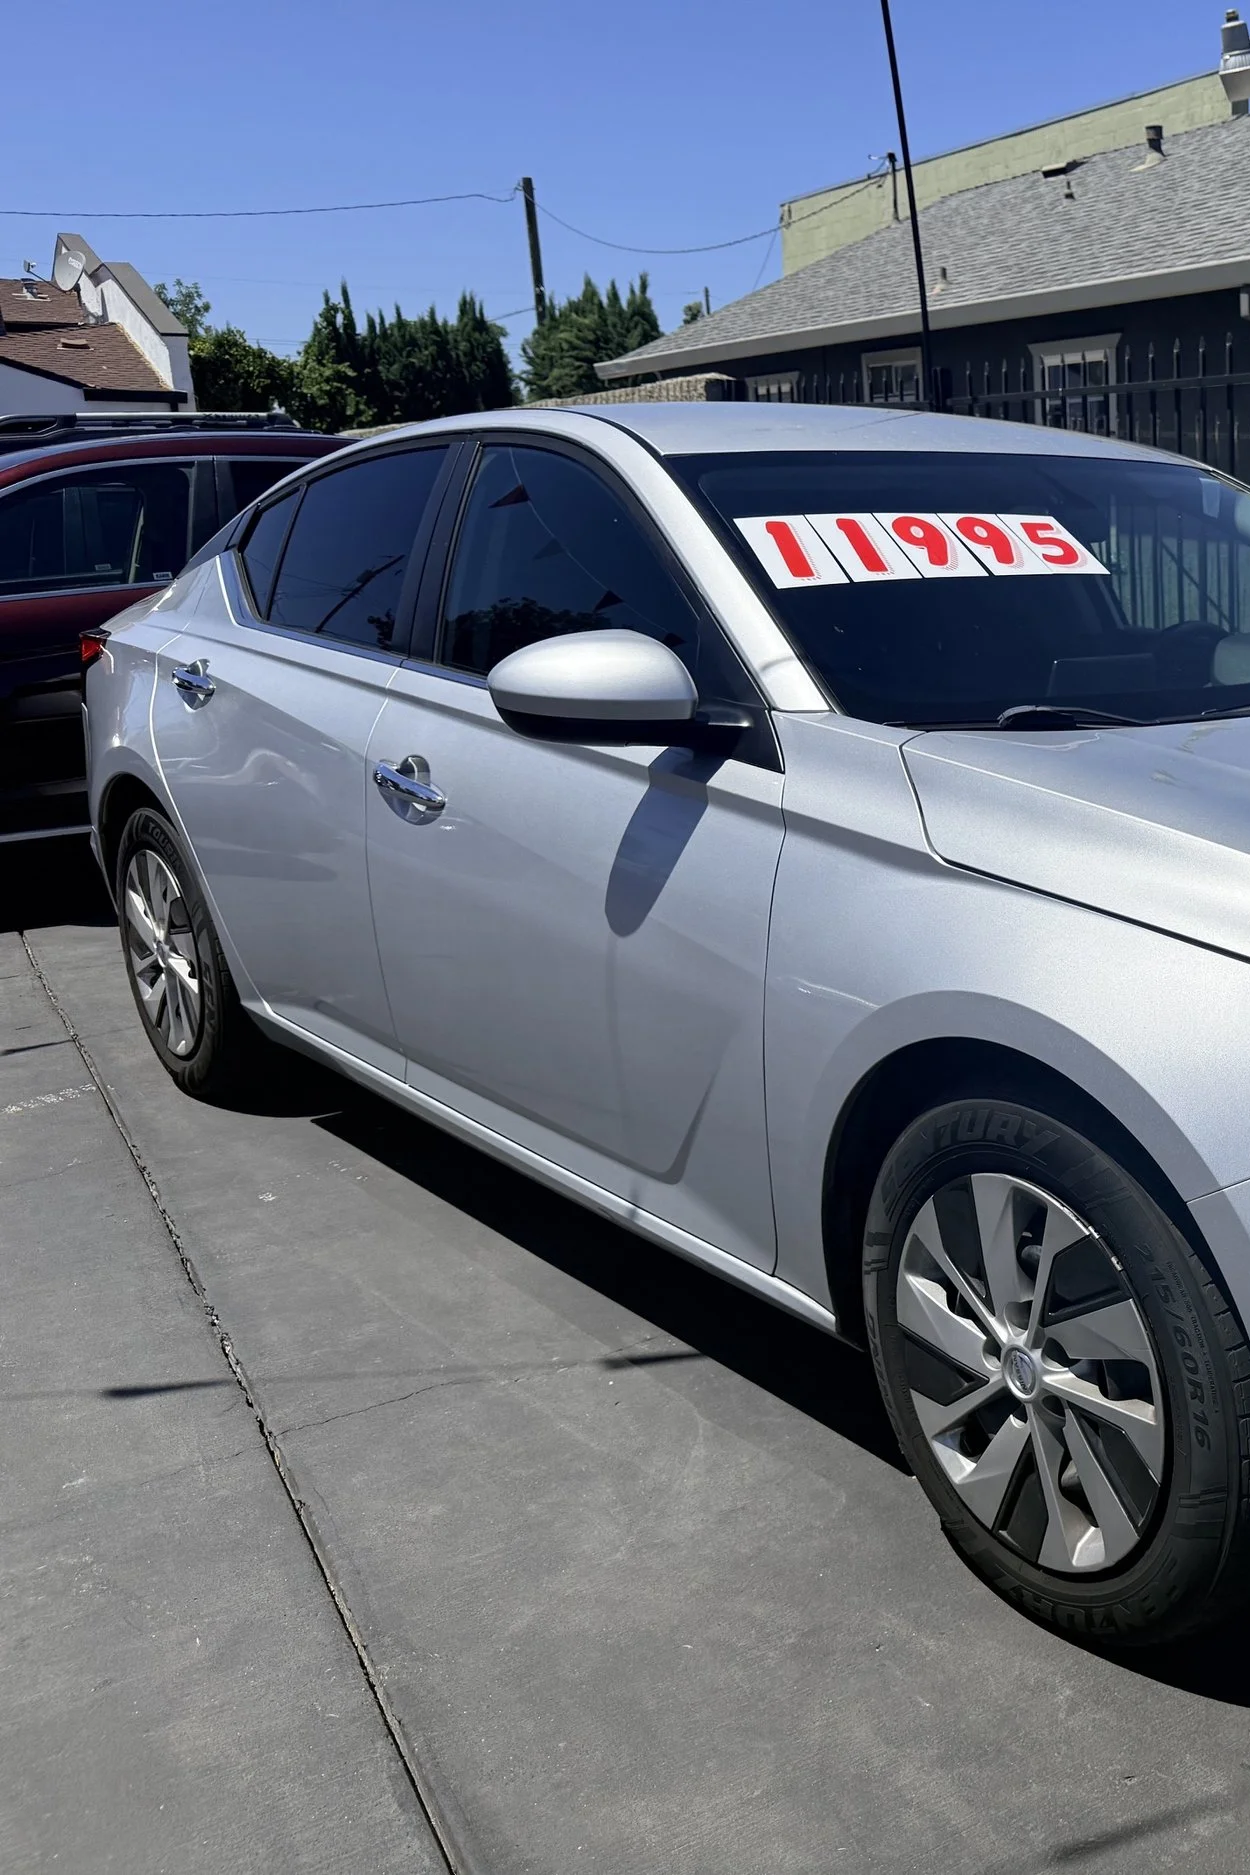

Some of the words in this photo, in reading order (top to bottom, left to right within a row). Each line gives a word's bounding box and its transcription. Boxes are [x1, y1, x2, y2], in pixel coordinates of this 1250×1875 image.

[765, 515, 1086, 580] 11995
[147, 821, 186, 878] TOURIN
[1135, 1240, 1210, 1453] 215/60R16
